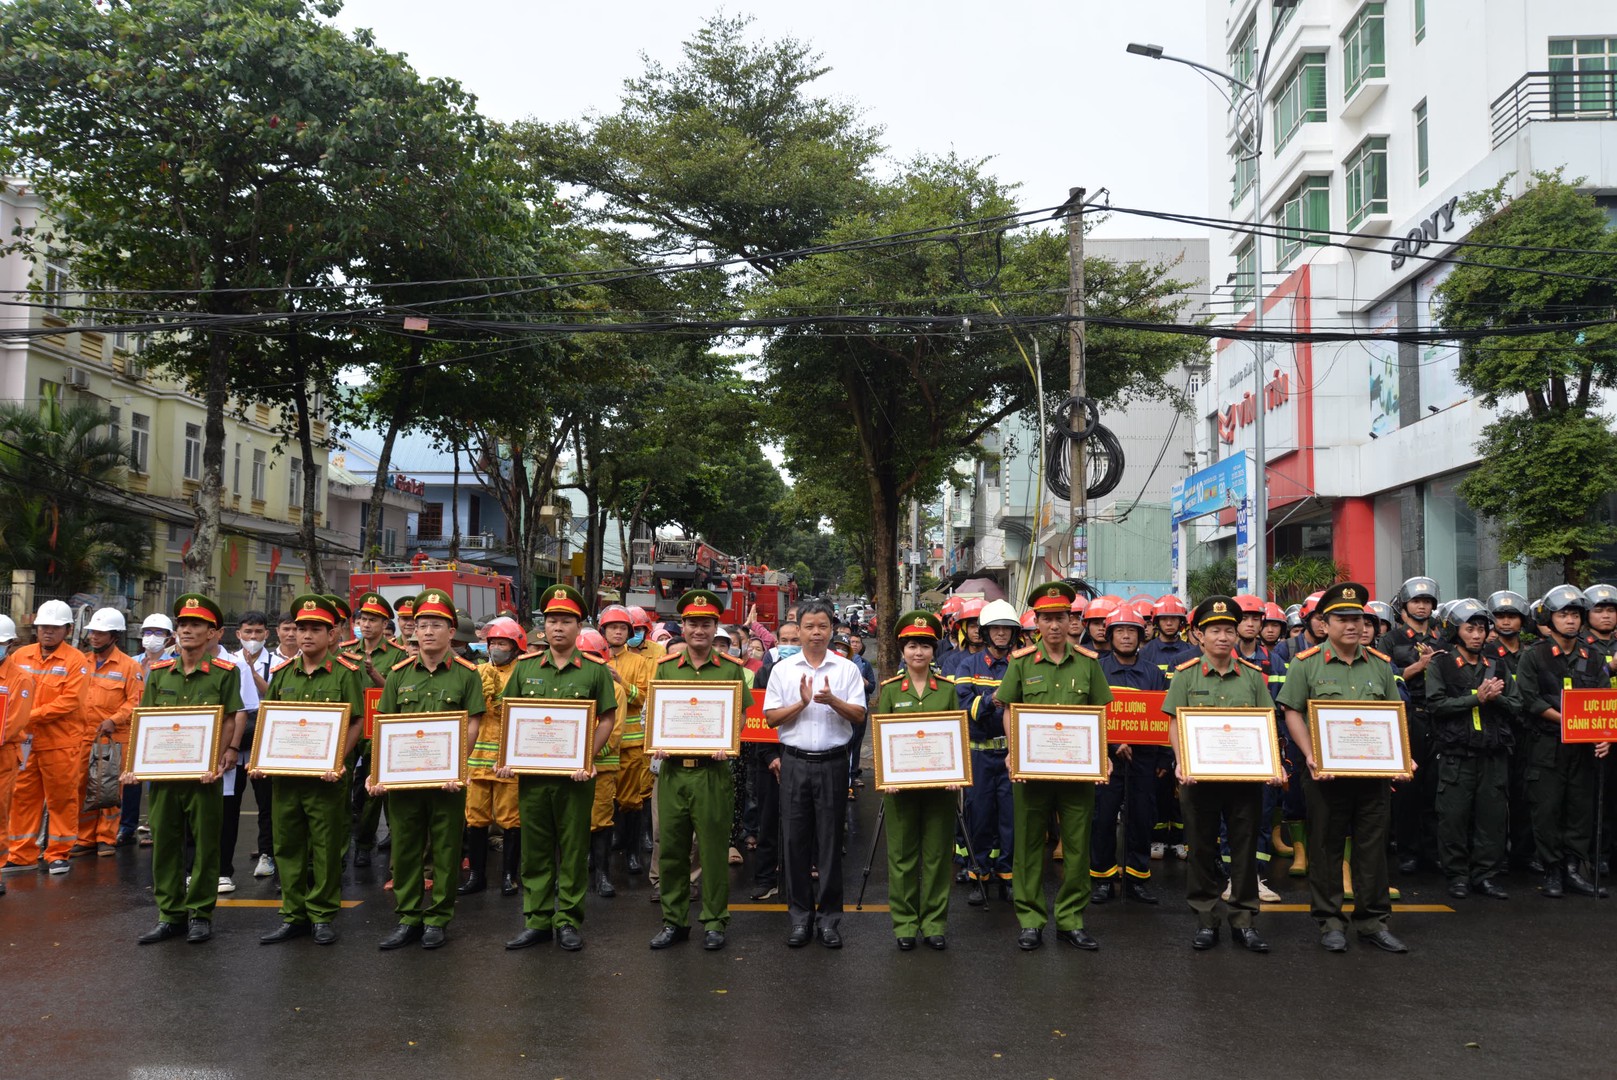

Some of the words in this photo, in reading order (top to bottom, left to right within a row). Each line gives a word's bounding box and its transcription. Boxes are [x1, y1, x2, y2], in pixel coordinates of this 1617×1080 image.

[1391, 196, 1458, 270] SONY
[1110, 700, 1123, 715] LỰC
[1125, 701, 1147, 715] LƯỢNG
[1584, 699, 1600, 713] LỰC
[746, 717, 760, 729] CCC
[1107, 717, 1119, 731] SÁT
[1121, 720, 1138, 731] PCCC
[1140, 718, 1149, 731] VÀ
[1150, 721, 1168, 732] CNCH
[1567, 715, 1590, 730] CẢNH
[1592, 716, 1607, 730] SÁT
